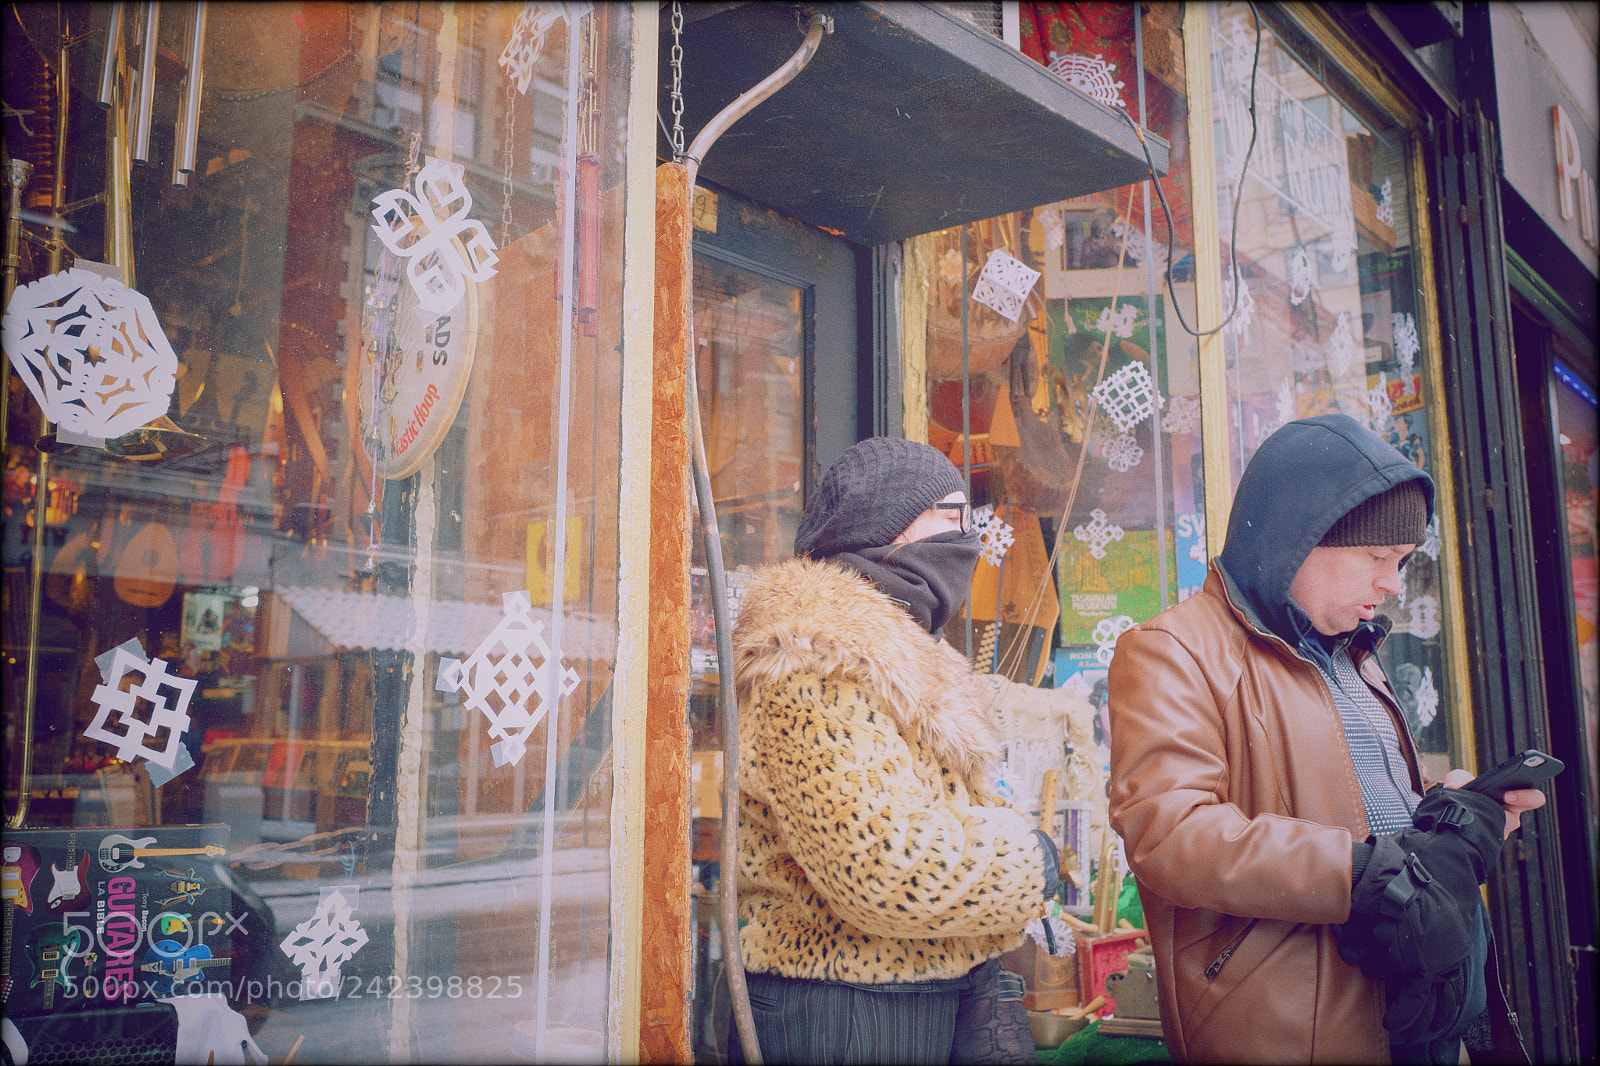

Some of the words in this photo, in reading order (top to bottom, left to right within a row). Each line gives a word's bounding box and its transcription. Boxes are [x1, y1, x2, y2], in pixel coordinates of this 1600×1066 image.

[1306, 114, 1343, 171] SELL
[413, 383, 440, 428] Hoop
[97, 881, 106, 896] LA
[141, 892, 149, 909] Tony
[96, 900, 106, 934] BIBLE
[141, 910, 149, 932] Bacon
[104, 876, 137, 1001] GUITARES
